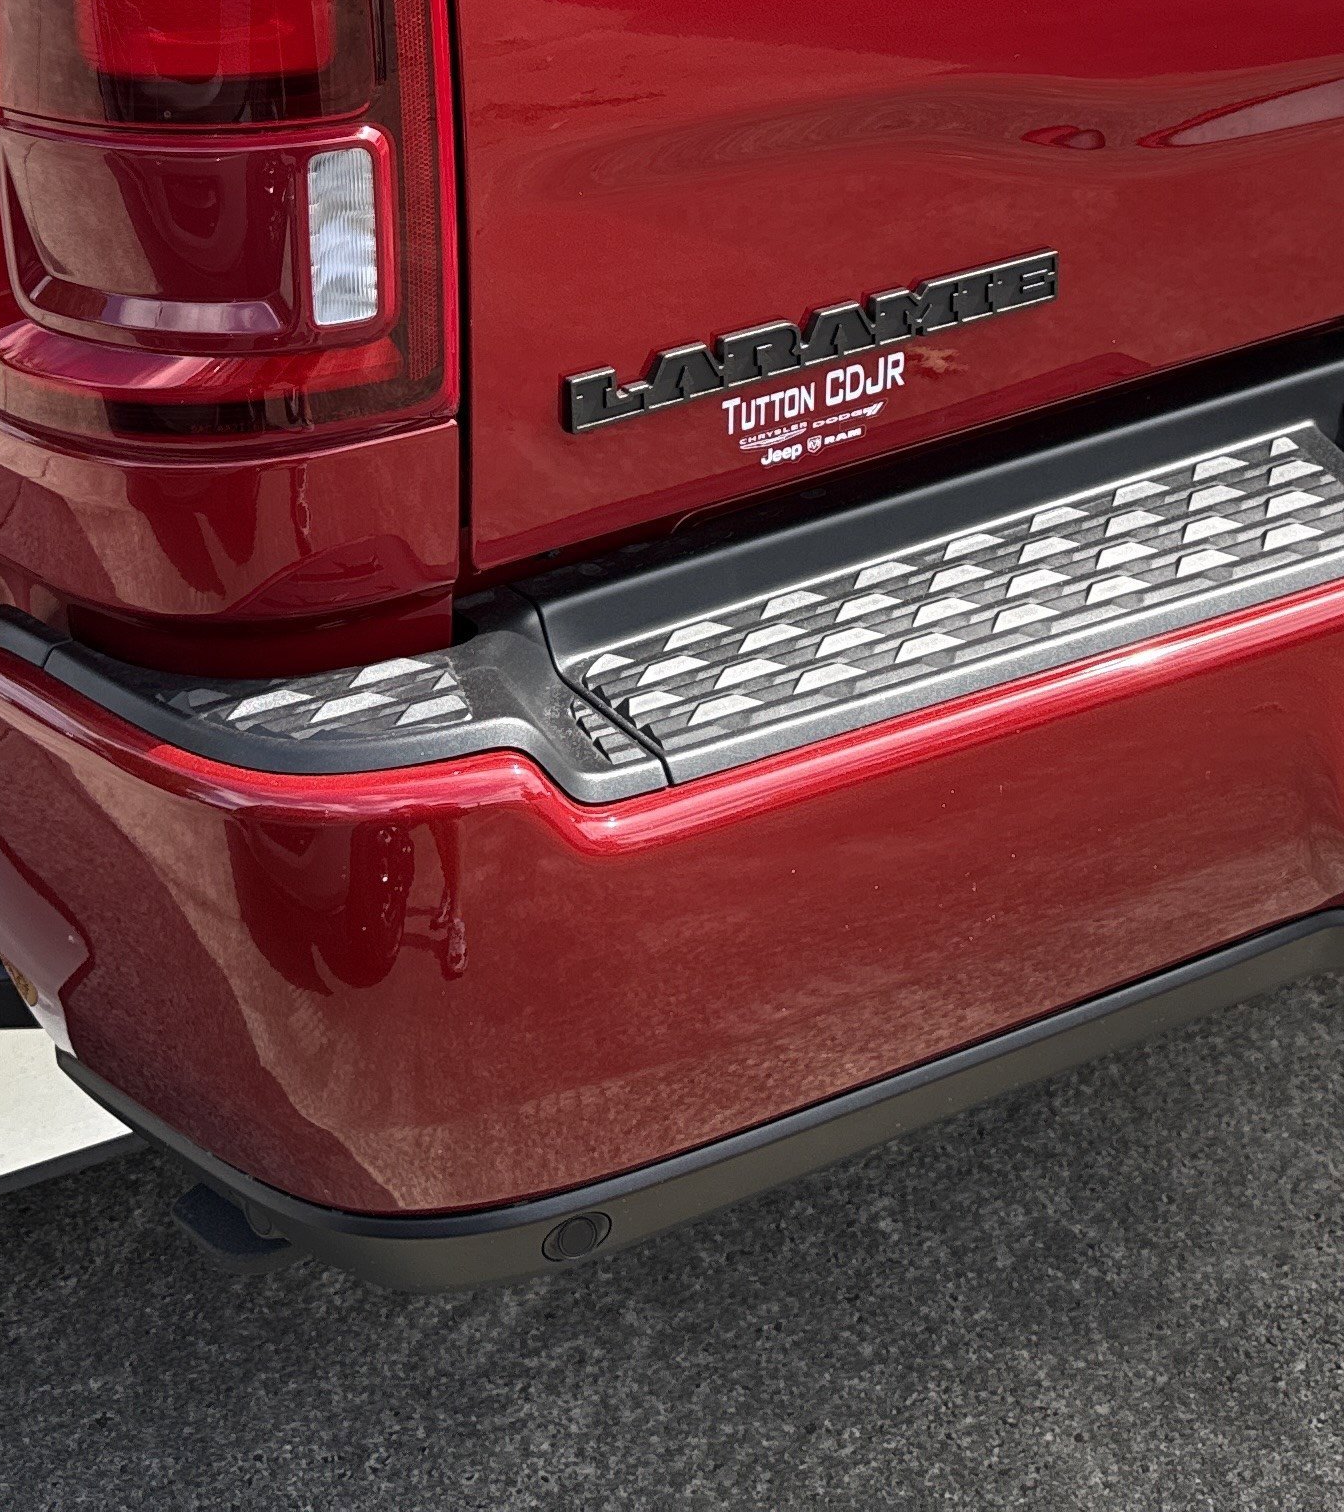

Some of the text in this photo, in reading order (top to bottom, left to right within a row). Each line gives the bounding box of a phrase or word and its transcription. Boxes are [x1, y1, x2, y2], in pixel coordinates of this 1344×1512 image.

[565, 249, 1058, 433] LARAMIE
[825, 351, 905, 407] CDJR
[739, 421, 808, 445] CHRYSLER
[760, 427, 862, 466] Jeep RAM
